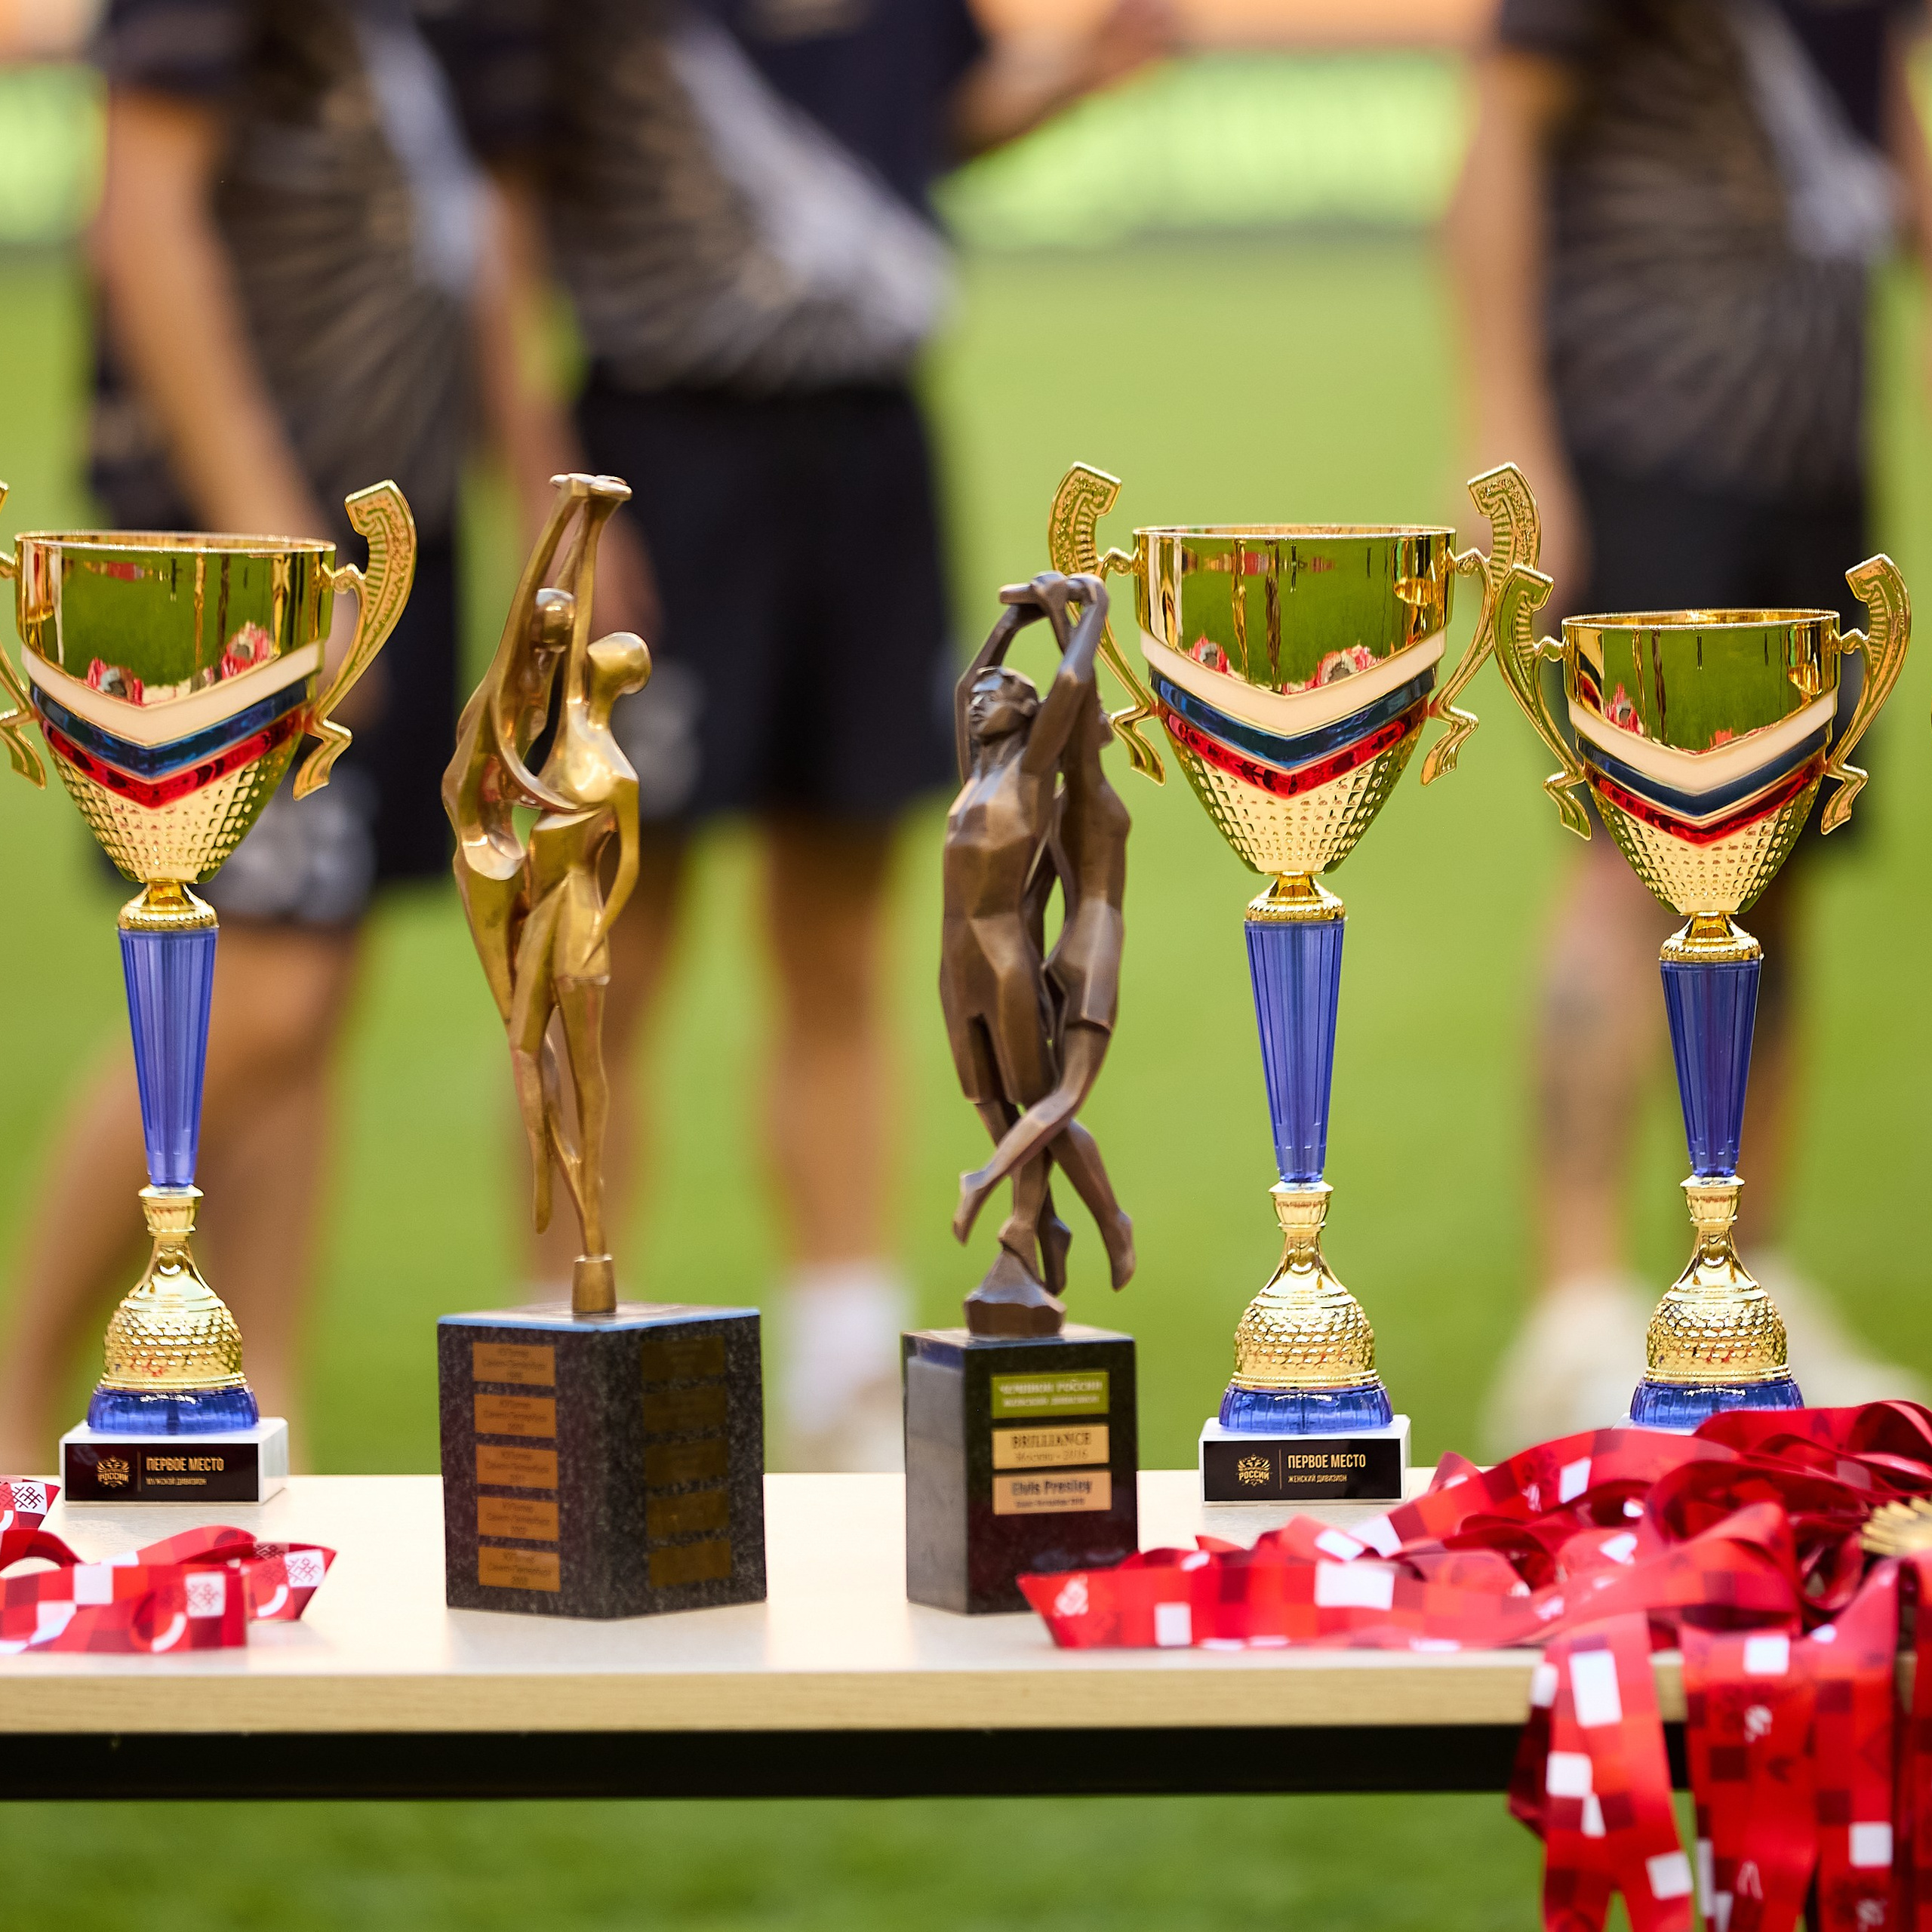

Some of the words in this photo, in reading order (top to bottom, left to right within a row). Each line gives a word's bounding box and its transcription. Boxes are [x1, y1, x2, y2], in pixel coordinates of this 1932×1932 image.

[1012, 1432, 1091, 1448] BRILLIANCE
[146, 1457, 187, 1471] ПЕРВОЕ
[189, 1457, 225, 1471] МЕСТО
[1287, 1454, 1328, 1469] ПЕРВОЕ
[1331, 1454, 1366, 1468] МЕСТО
[1238, 1470, 1270, 1481] РОССИИ
[1287, 1474, 1316, 1483] ЖЕНСКИЙ
[1316, 1474, 1347, 1483] ДИВИЗИОН
